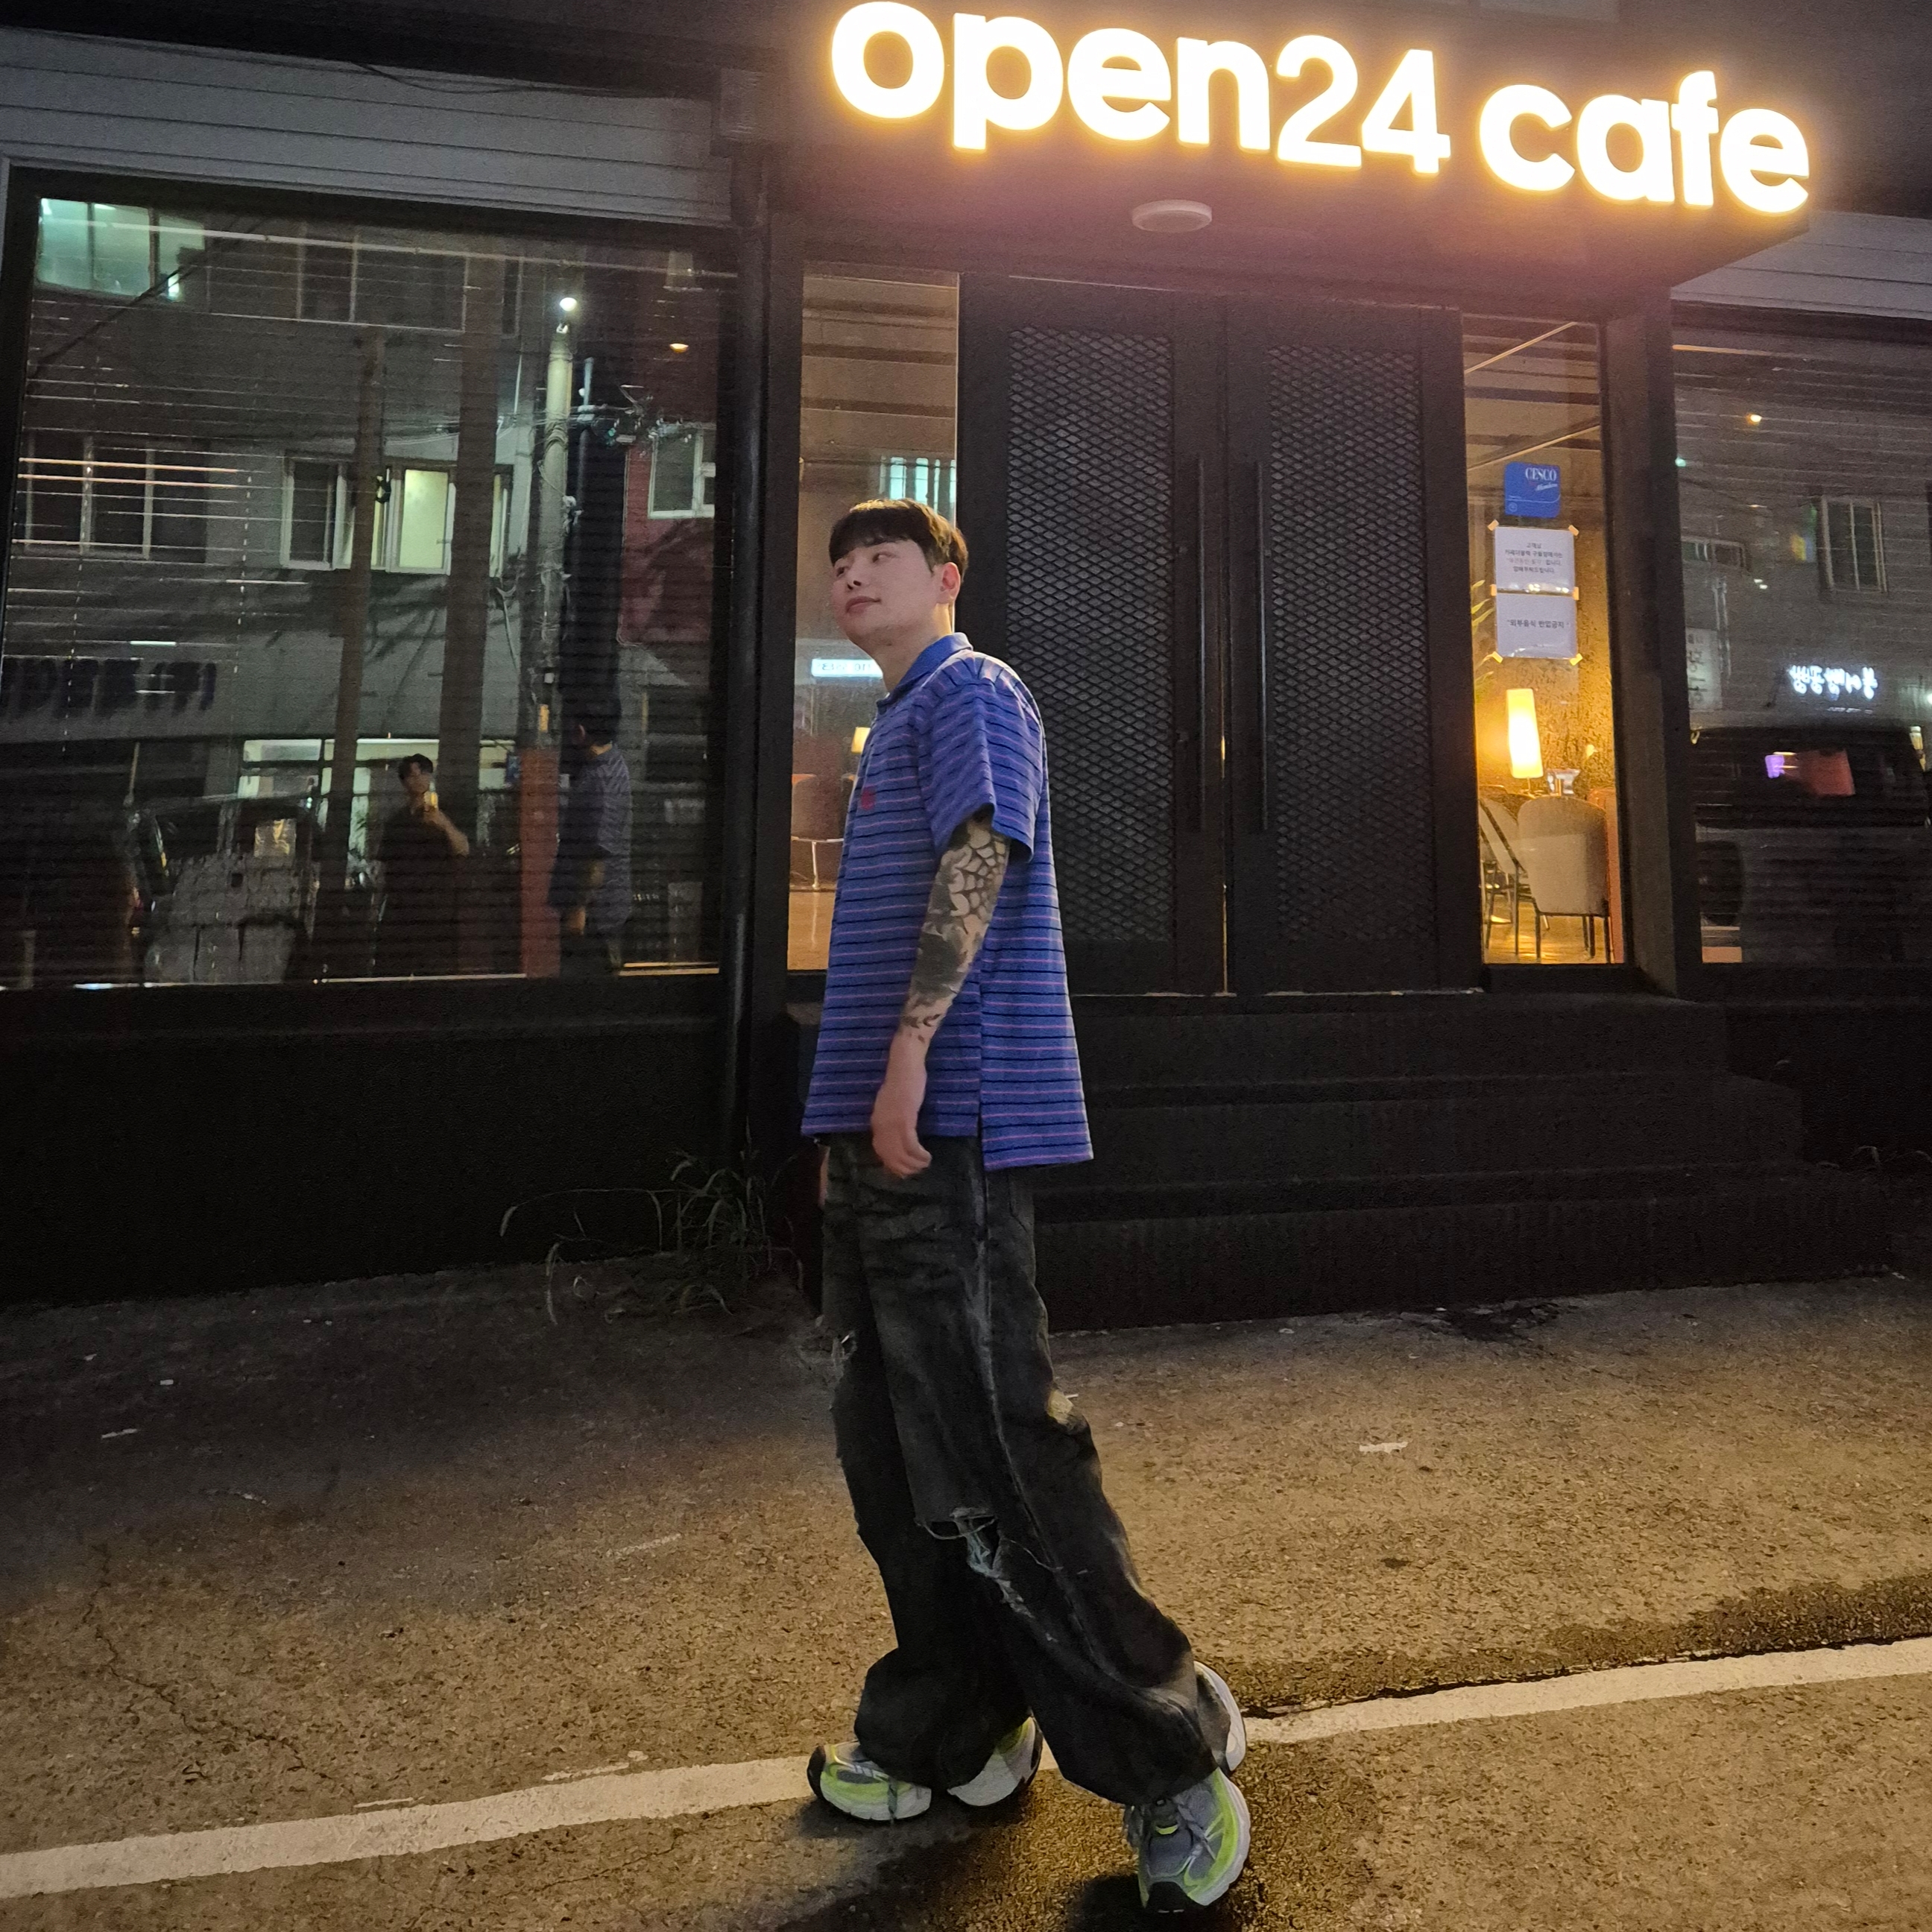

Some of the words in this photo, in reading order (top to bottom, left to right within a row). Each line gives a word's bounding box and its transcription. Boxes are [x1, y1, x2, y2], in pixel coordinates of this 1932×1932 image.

[832, 1, 1450, 173] open24
[1479, 70, 1809, 213] cafe
[1526, 468, 1556, 481] CESCO
